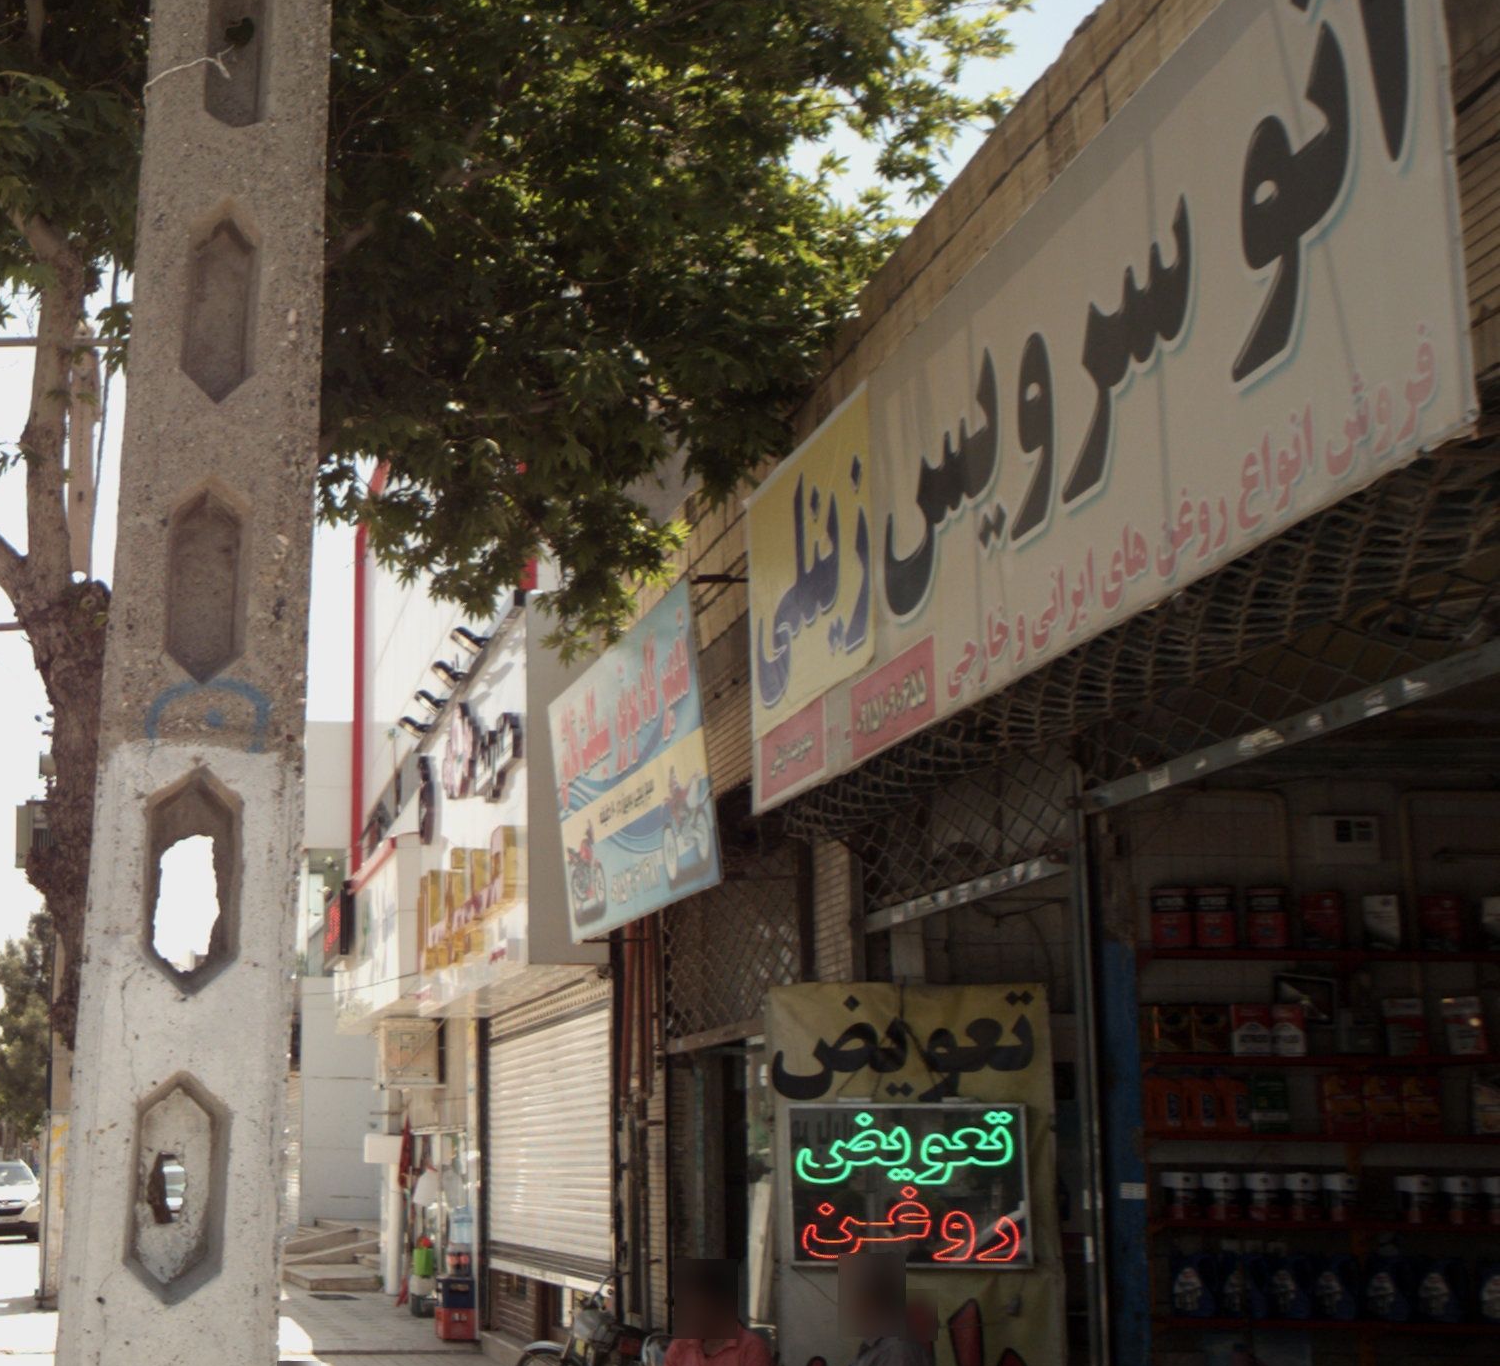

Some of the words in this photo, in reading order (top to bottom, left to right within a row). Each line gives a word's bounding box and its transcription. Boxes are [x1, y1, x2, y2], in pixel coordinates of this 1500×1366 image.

[884, 192, 1192, 617] سرویس
[1326, 323, 1436, 477] فروش
[1237, 401, 1315, 528] انواع
[757, 455, 871, 708] زینلی
[1102, 524, 1148, 610] های
[1155, 487, 1229, 578] روغن
[1015, 614, 1026, 662] و
[1032, 546, 1094, 649] ایرانی
[947, 604, 1010, 698] خارجی
[772, 990, 1036, 1102] تعویض
[796, 1110, 1014, 1185] تعویض
[802, 1185, 1021, 1262] روغن
